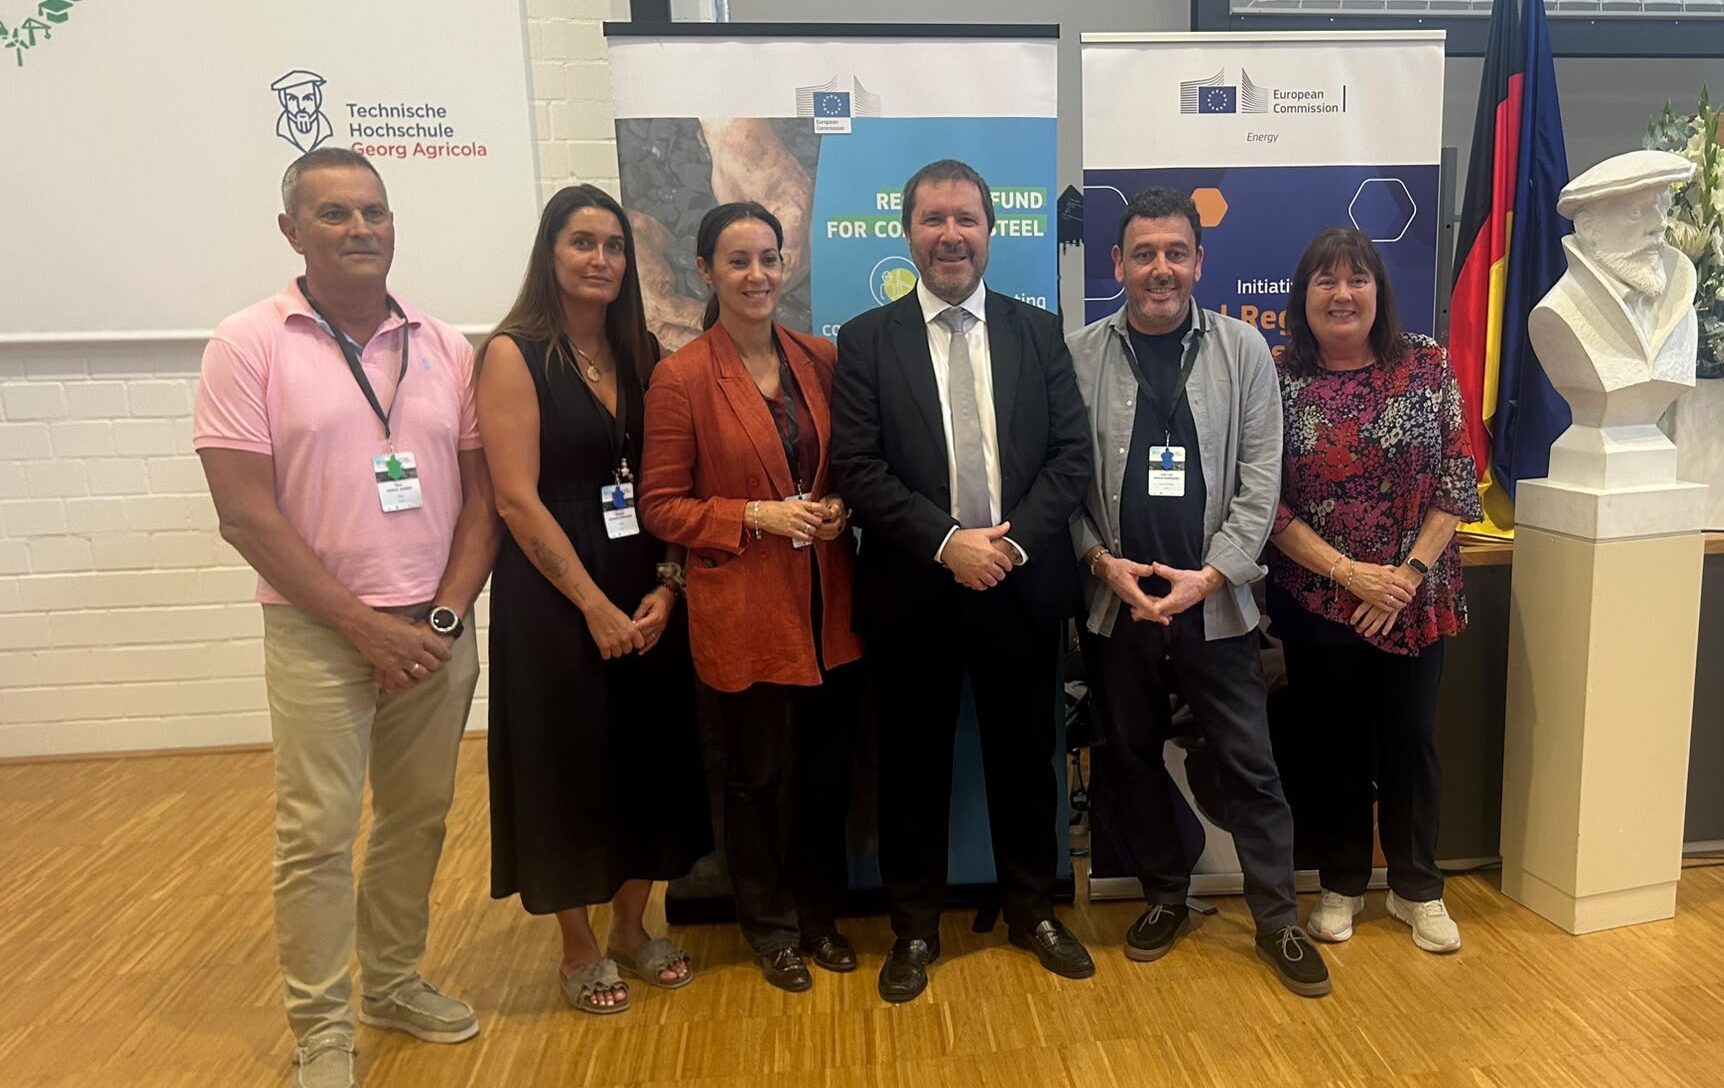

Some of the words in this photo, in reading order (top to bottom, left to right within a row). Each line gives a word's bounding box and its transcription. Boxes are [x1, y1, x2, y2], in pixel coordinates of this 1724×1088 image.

[1273, 89, 1325, 102] European
[346, 103, 447, 119] Technische
[1273, 103, 1339, 114] Commission
[349, 123, 454, 138] Hochschule
[1246, 132, 1279, 143] Energy
[351, 142, 407, 159] Georg
[413, 142, 487, 159] Agricola
[876, 192, 905, 210] RE
[990, 191, 1043, 209] FUND
[827, 221, 867, 238] FOR
[874, 221, 905, 238] CO
[1237, 278, 1293, 295] Initiati
